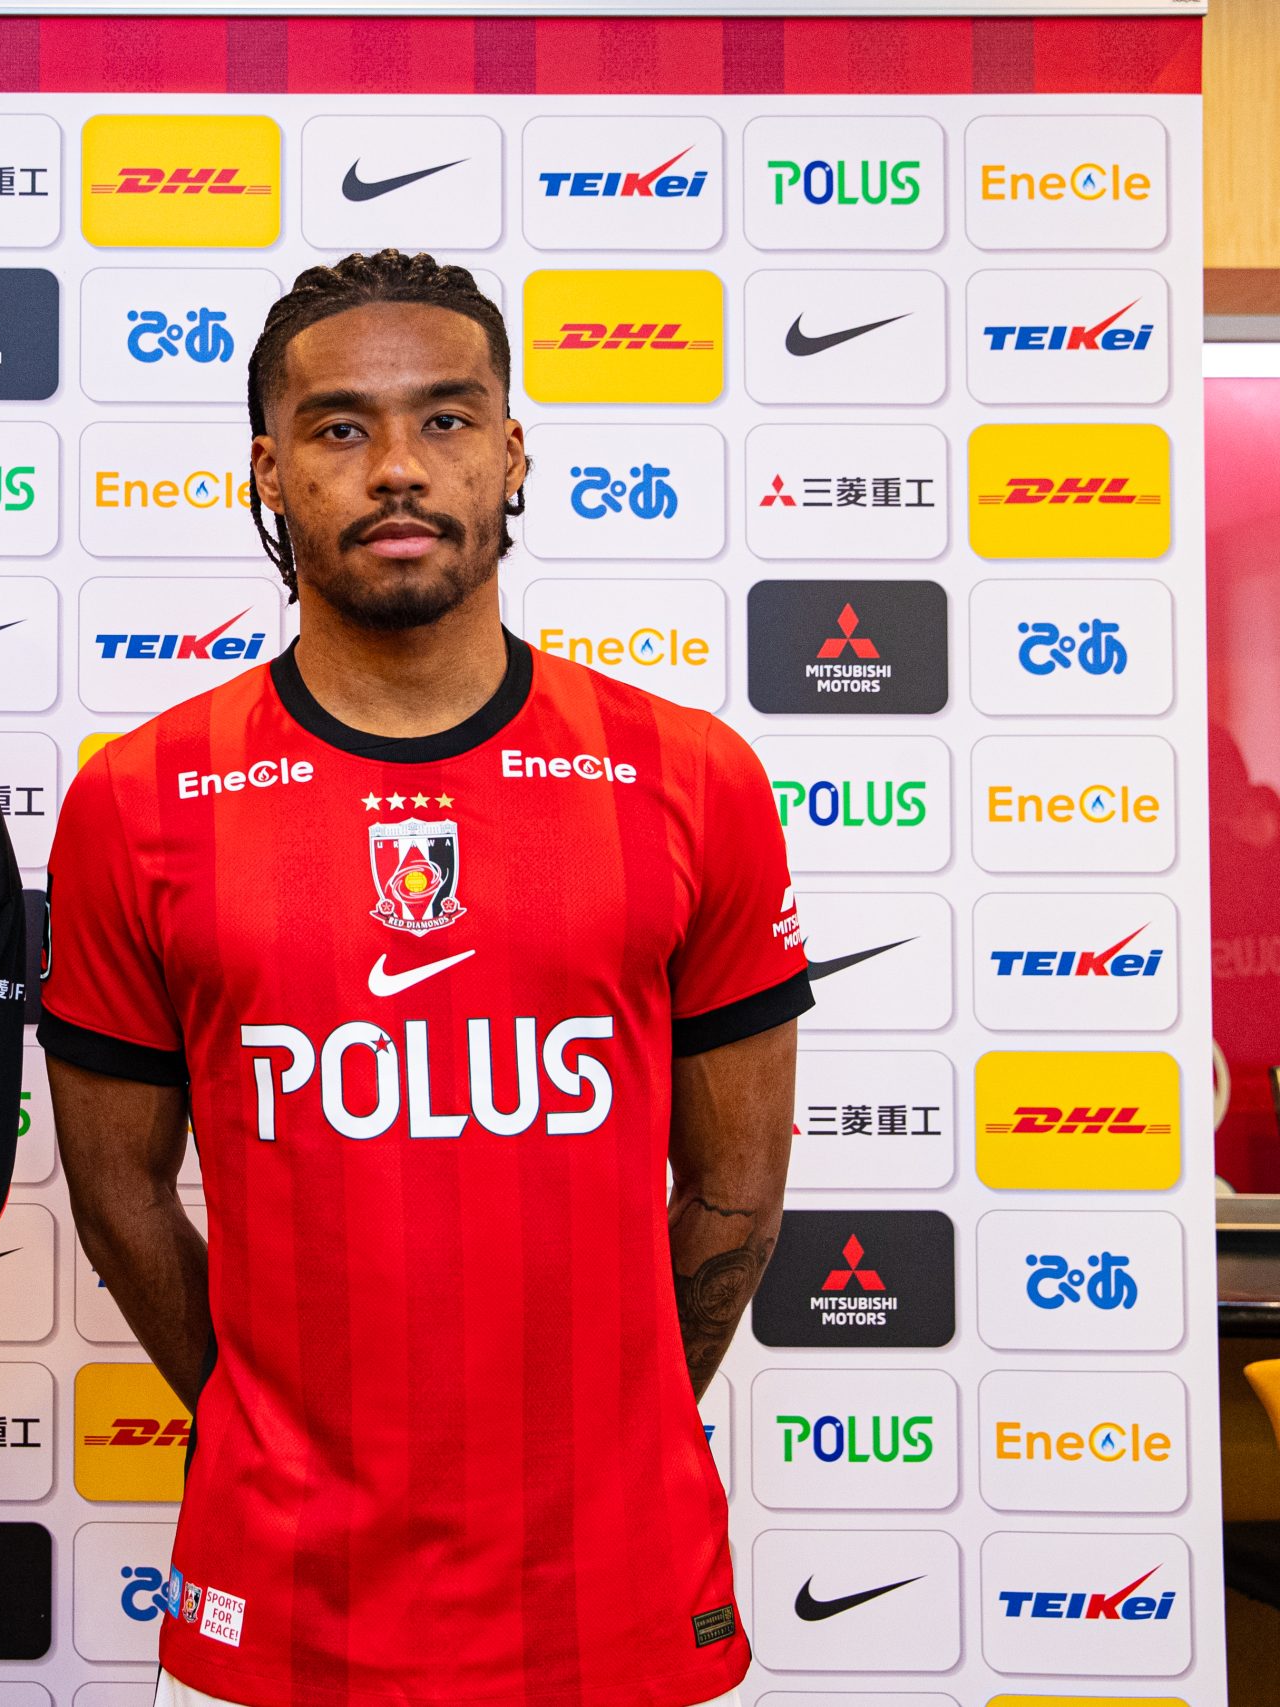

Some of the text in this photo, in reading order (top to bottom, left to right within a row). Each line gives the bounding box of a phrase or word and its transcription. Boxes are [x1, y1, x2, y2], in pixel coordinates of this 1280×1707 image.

[117, 168, 245, 194] DHL
[539, 149, 708, 198] TEIKei
[767, 159, 921, 206] POLUS
[981, 162, 1151, 202] EneCle
[559, 323, 689, 349] DHL
[983, 303, 1154, 351] TEIKei
[803, 477, 935, 507] 三菱重工
[1004, 478, 1136, 504] DHL
[95, 609, 267, 661] TEIKei
[805, 664, 892, 678] MITSUBISHI
[816, 678, 881, 693] MOTORS
[178, 758, 313, 799] EneCle
[502, 750, 636, 783] EneCle
[772, 780, 927, 827] POLUS
[987, 783, 1160, 824] EneCle
[388, 917, 449, 930] RED DIAMONDS
[990, 927, 1164, 977] TEIKei
[240, 1016, 614, 1141] POLUS
[807, 1104, 942, 1136] 三菱重工
[1011, 1106, 1147, 1134] DHL
[810, 1296, 898, 1311] MITSUBISHI
[821, 1311, 887, 1326] MOTORS
[110, 1417, 192, 1447] DH
[776, 1415, 933, 1463] POLUS
[995, 1421, 1172, 1463] EneCle
[207, 1591, 244, 1614] SPORTS
[998, 1568, 1176, 1621] TEIKei
[204, 1619, 239, 1641] PEACE!
[212, 1607, 233, 1625] FOR
